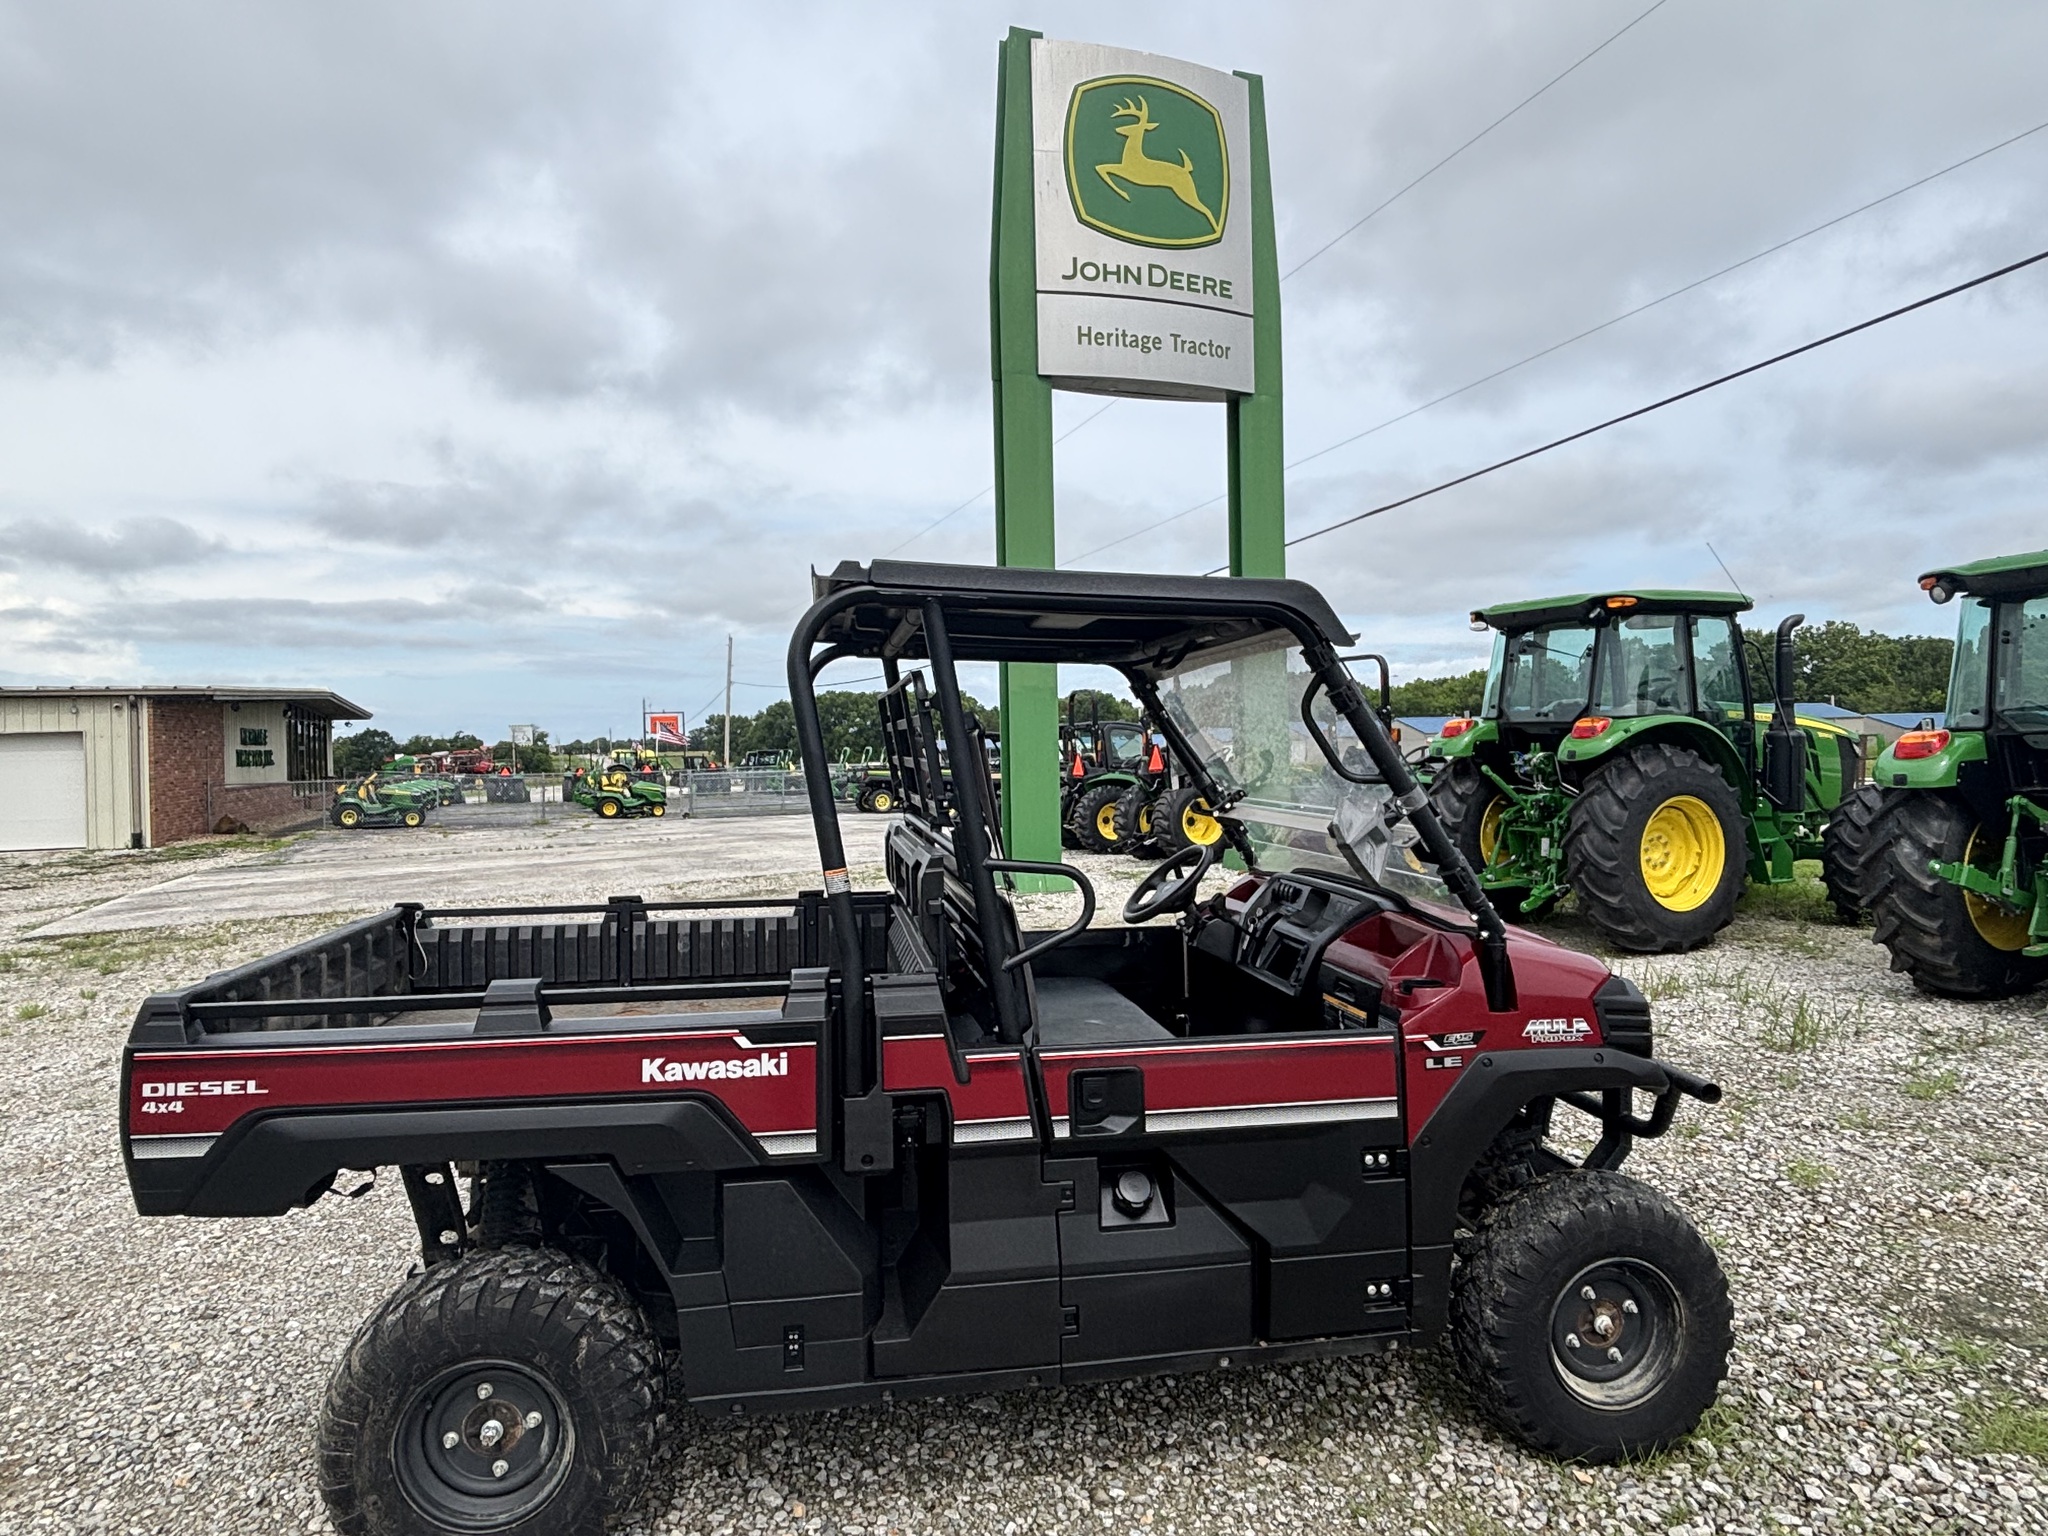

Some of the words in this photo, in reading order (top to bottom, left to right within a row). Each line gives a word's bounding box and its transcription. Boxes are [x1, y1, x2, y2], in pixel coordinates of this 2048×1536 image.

[1062, 257, 1142, 286] JOHN
[1148, 263, 1233, 300] DEERE
[1077, 325, 1163, 354] Heritage
[1169, 333, 1231, 360] Tractor
[1522, 1018, 1594, 1037] MULE
[641, 1052, 788, 1083] Kawasaki
[1425, 1056, 1463, 1069] LE
[142, 1080, 269, 1097] DIESEL
[141, 1100, 185, 1114] 4x4
